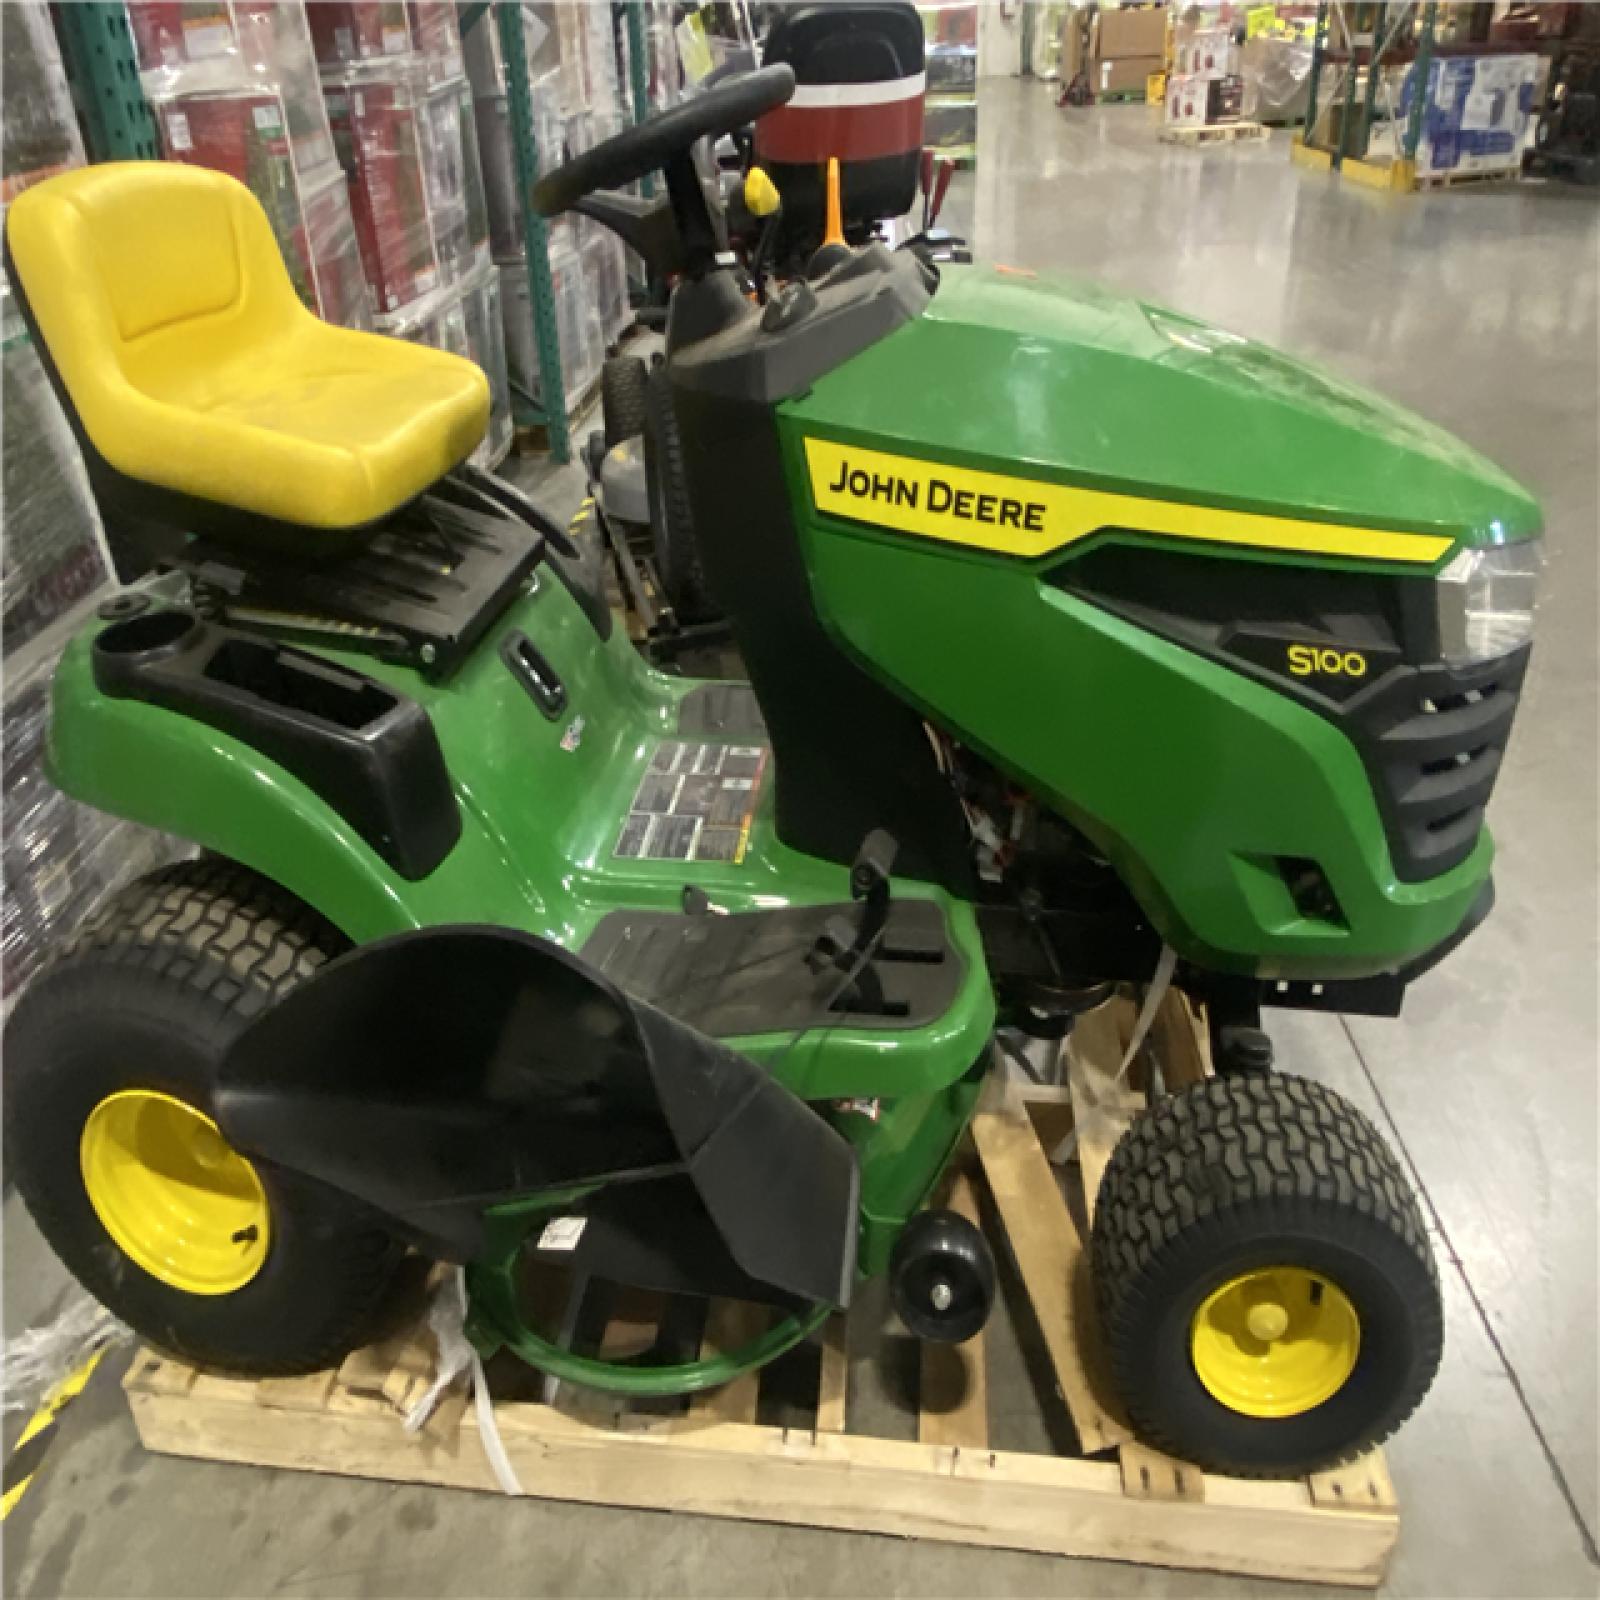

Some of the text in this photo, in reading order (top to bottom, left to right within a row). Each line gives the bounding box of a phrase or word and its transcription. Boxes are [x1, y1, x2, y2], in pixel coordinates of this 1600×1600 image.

[829, 461, 1046, 531] JOHN DEERE
[1287, 644, 1366, 676] S100
